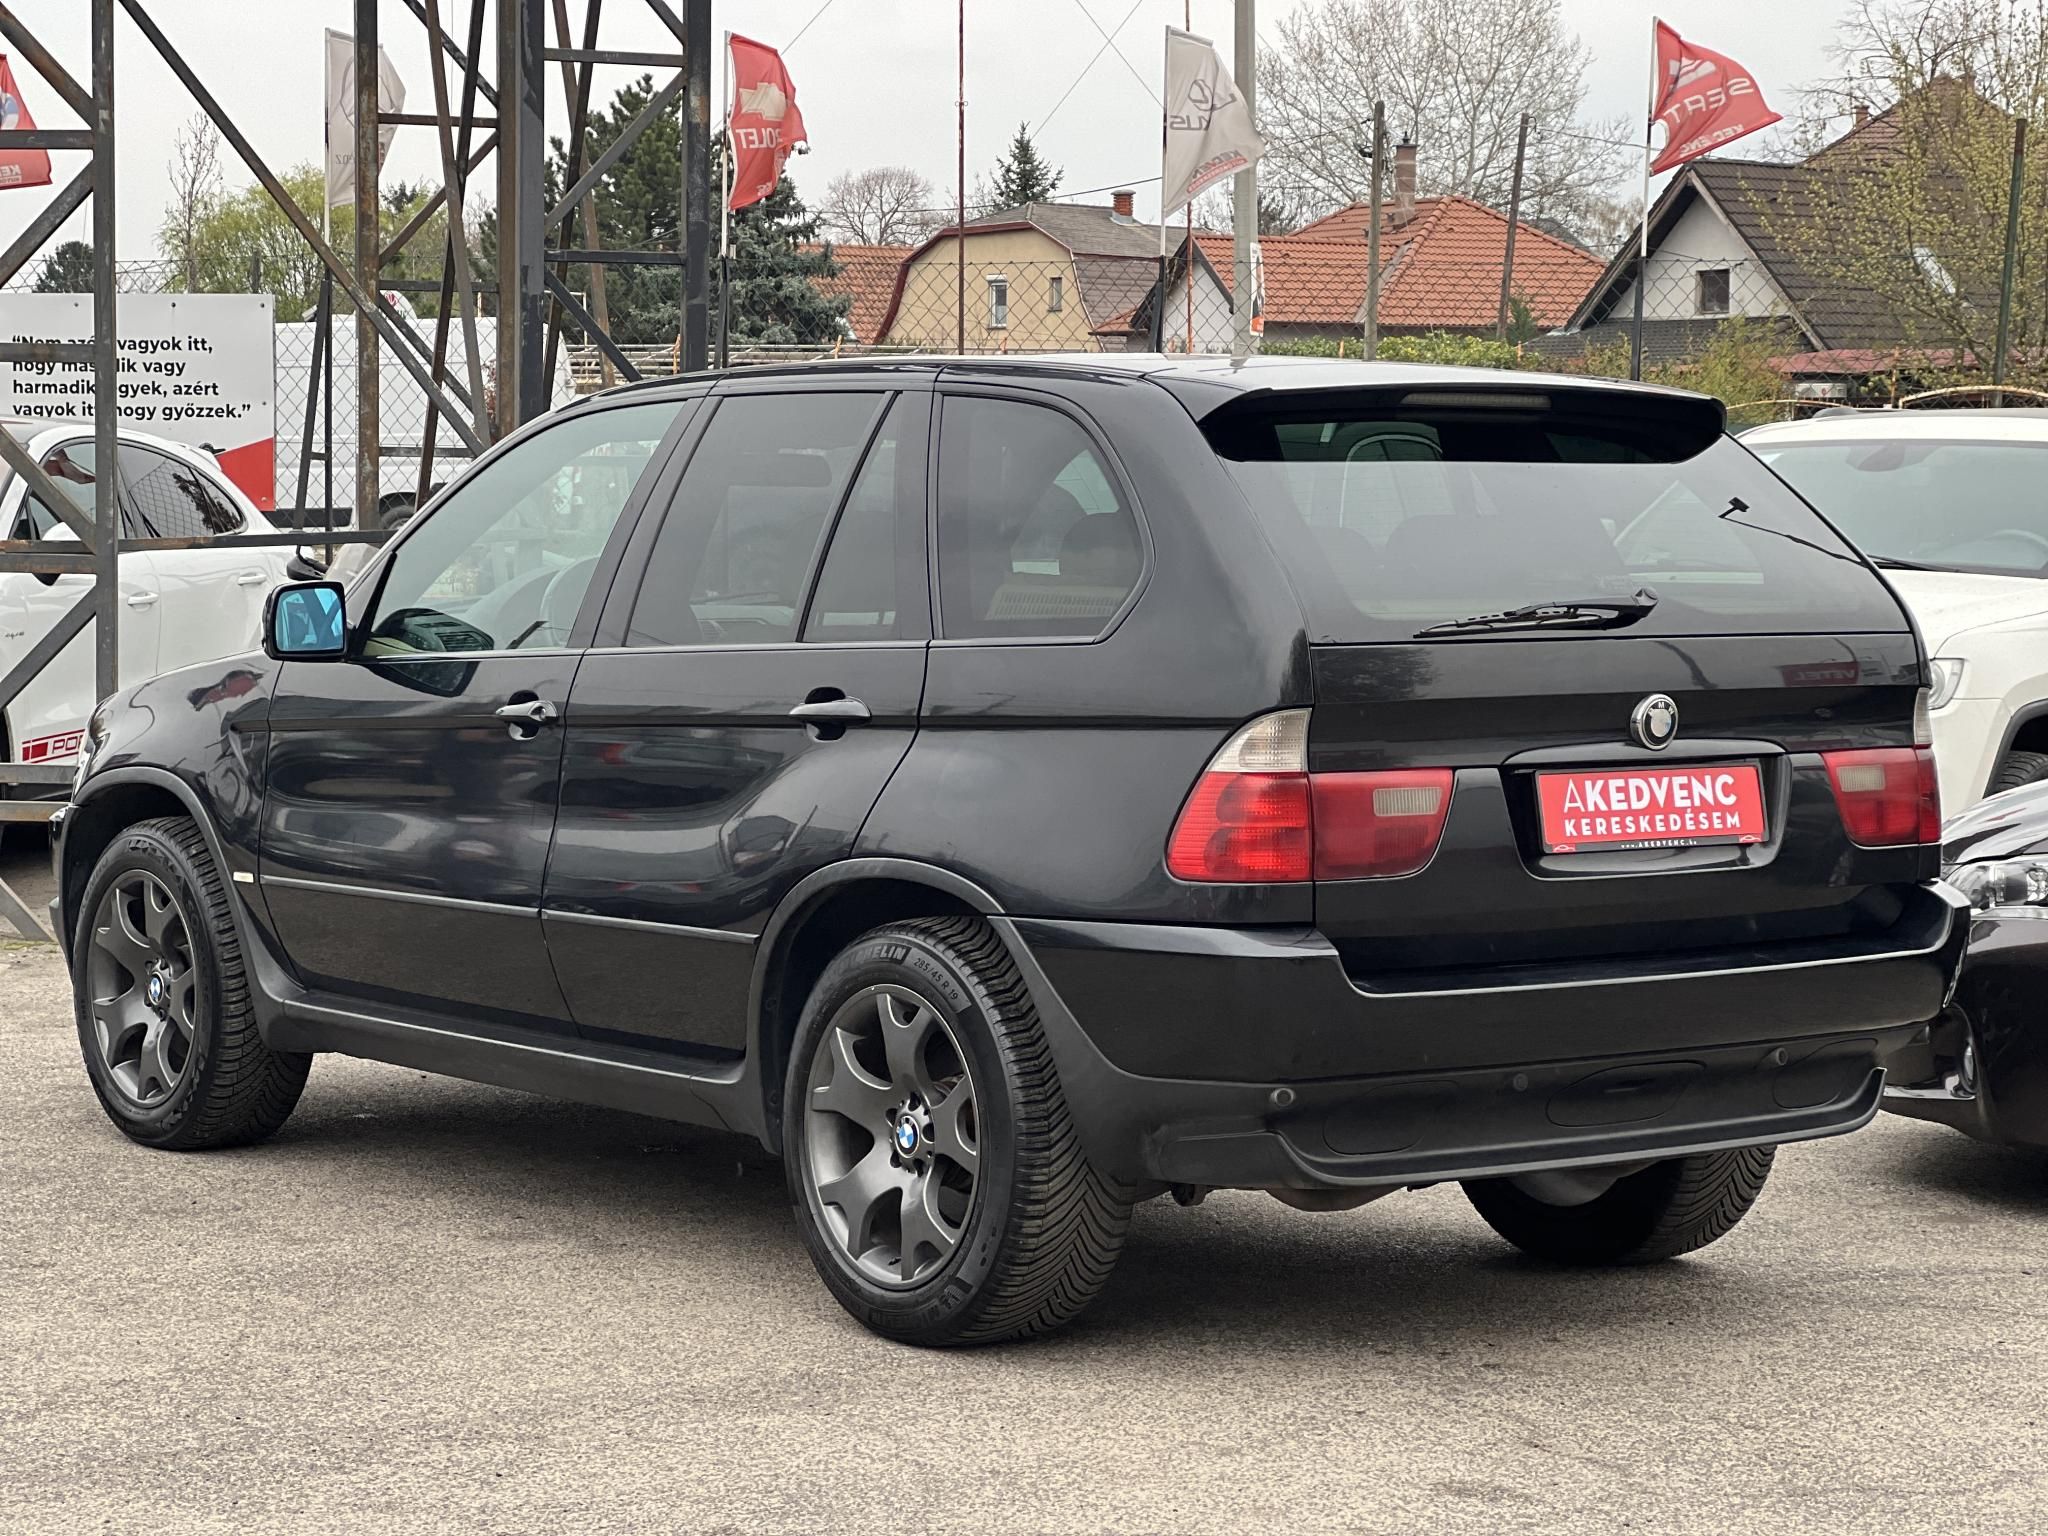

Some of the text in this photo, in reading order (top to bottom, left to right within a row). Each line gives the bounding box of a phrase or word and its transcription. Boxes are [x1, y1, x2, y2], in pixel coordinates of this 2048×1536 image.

[117, 336, 182, 354] vagyok
[187, 335, 213, 354] itt,
[142, 361, 187, 376] vagy
[13, 379, 95, 394] harmadik
[172, 380, 219, 396] azért
[161, 402, 251, 421] győzzek.”
[1563, 808, 1741, 837] KERESKEDÉSEM
